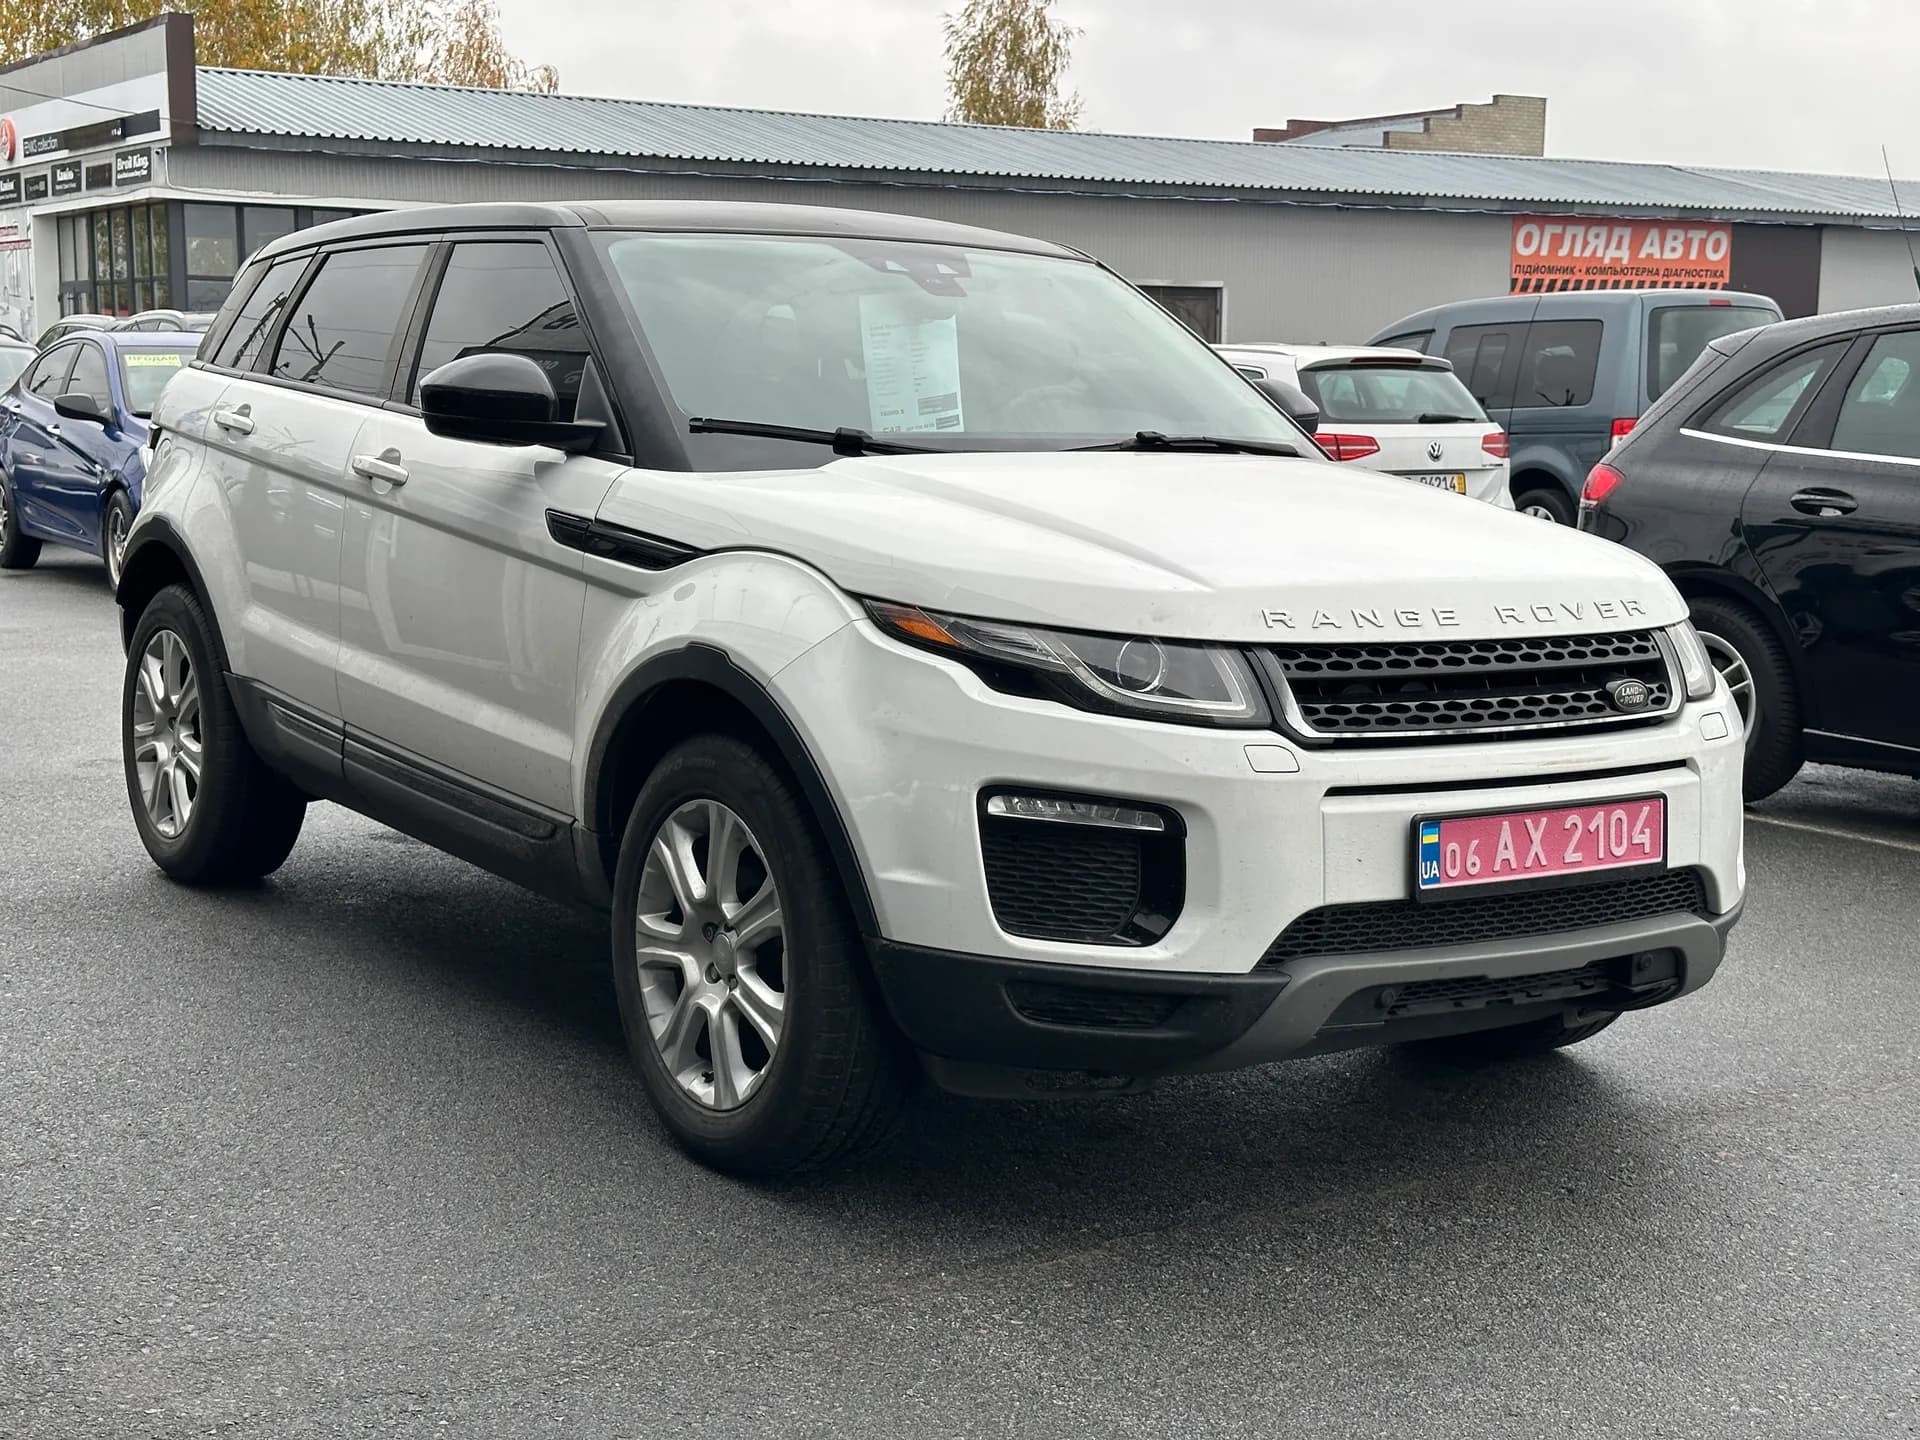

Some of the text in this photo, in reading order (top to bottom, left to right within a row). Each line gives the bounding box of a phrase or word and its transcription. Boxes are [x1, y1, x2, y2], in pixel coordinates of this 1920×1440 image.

[1515, 223, 1729, 265] ОГЛЯД АВТО
[1514, 264, 1576, 276] ПІДЙОМНИК
[1262, 599, 1647, 629] RANGE ROVER
[1621, 686, 1639, 696] LAND
[1624, 694, 1644, 704] ROVER
[1445, 805, 1651, 878] 06 AX 2104
[1422, 860, 1440, 880] UA
